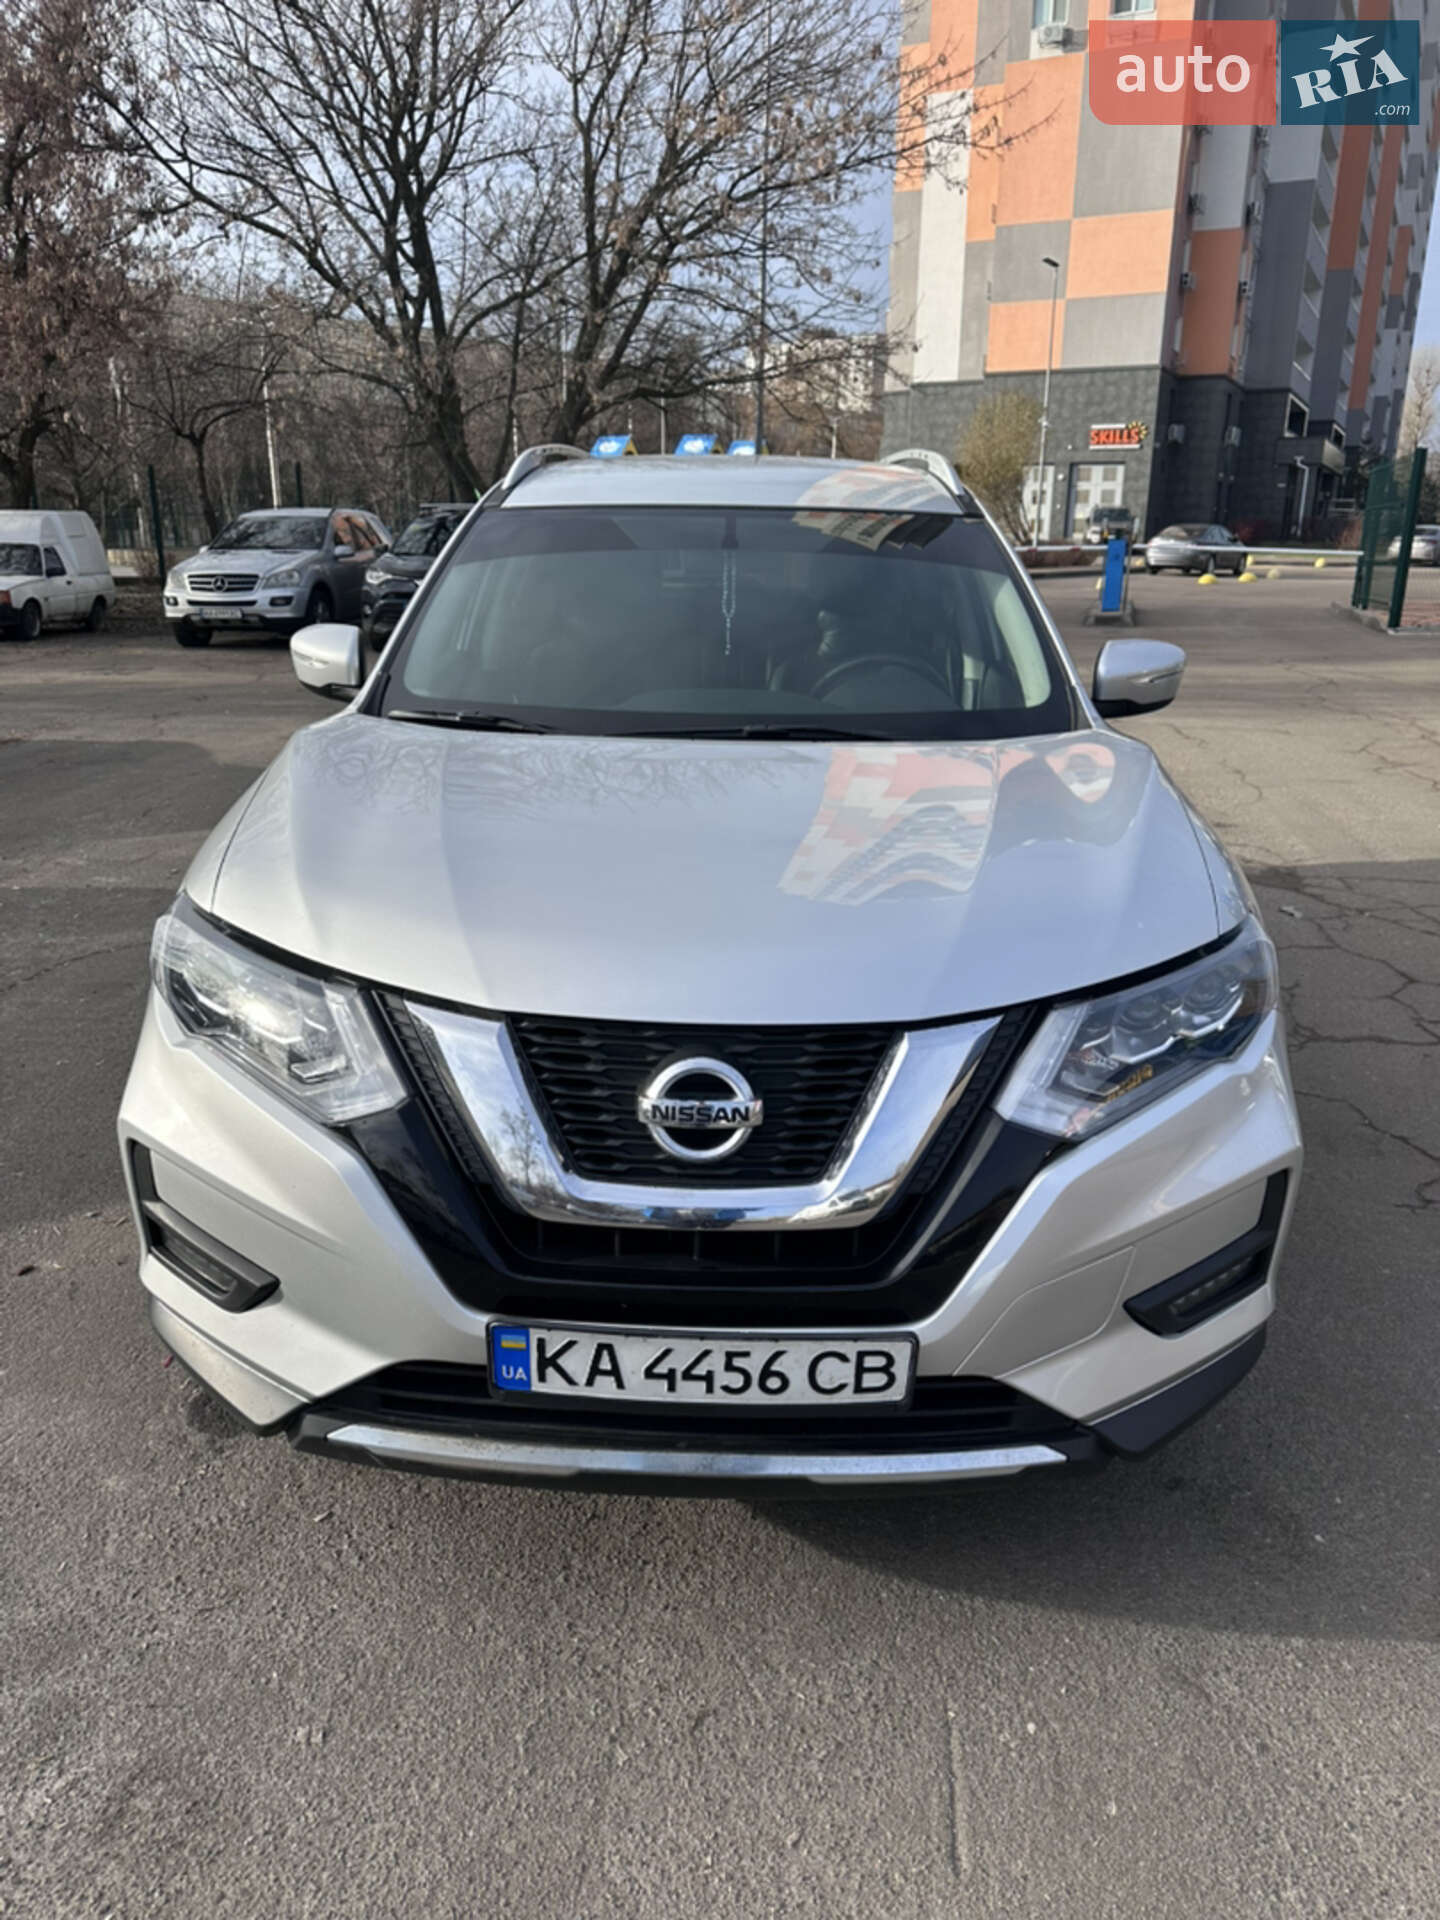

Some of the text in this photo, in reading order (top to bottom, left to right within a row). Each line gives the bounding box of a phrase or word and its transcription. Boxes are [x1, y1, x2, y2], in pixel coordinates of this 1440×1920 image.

[1090, 428, 1140, 445] SKILLS
[651, 1104, 750, 1123] NISSAN
[502, 1365, 527, 1381] UA
[536, 1337, 897, 1396] KA 4456 CB
